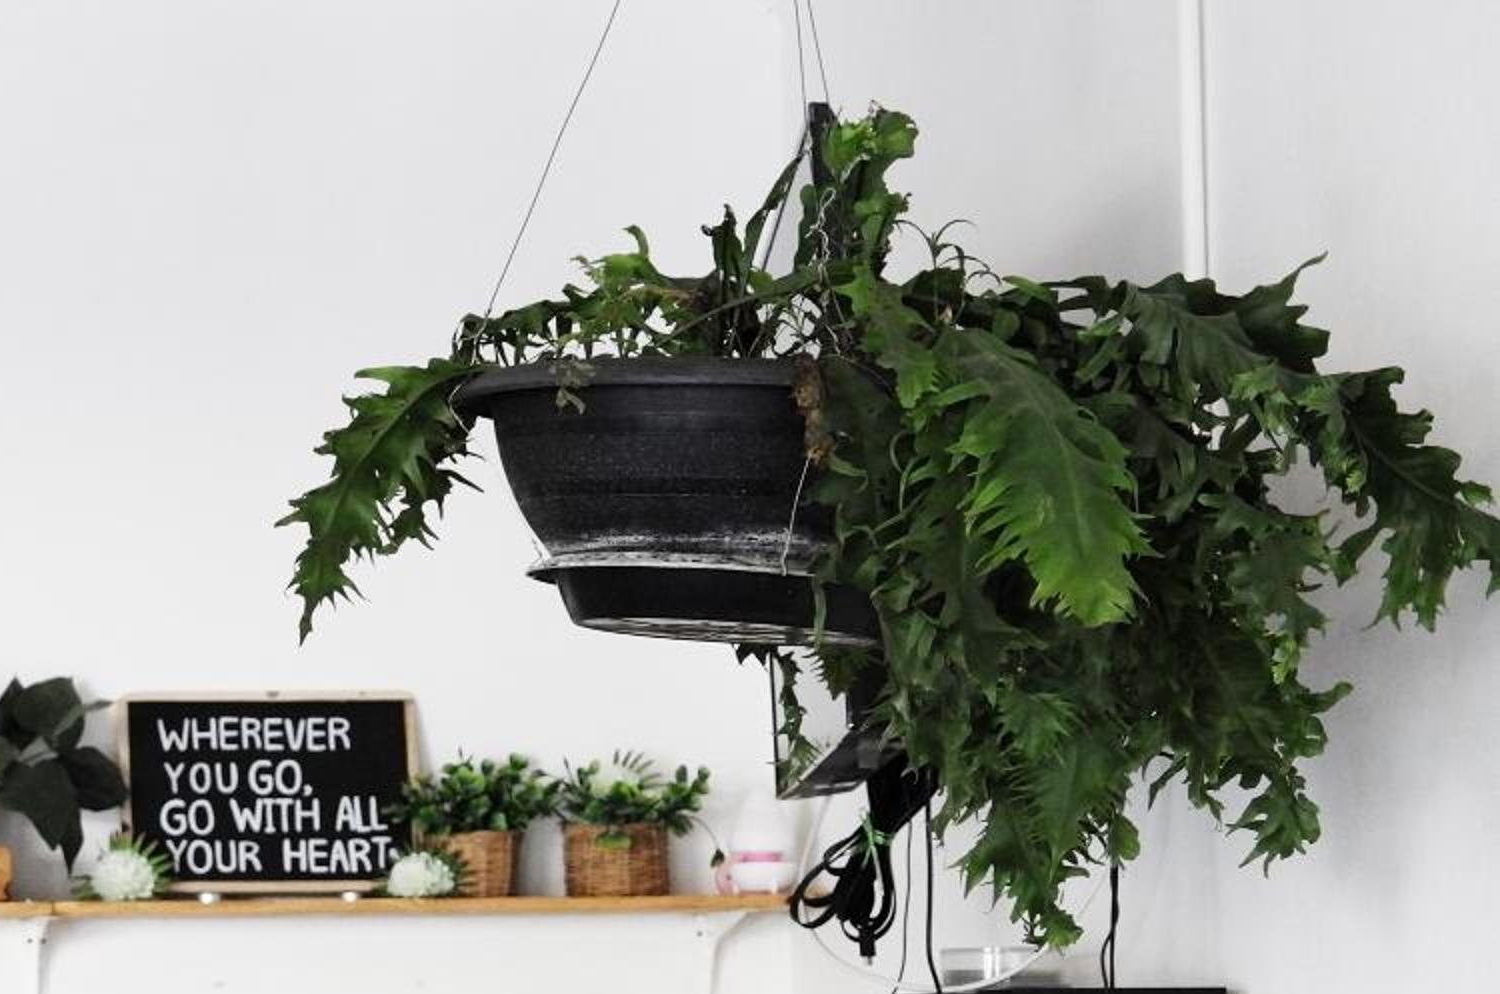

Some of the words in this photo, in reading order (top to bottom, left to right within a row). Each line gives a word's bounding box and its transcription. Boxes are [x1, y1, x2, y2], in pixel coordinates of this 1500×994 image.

[157, 716, 351, 752] WHEREVER
[163, 762, 239, 794] YOU
[248, 759, 313, 796] GO,
[159, 798, 215, 836] GO
[229, 798, 321, 833] WITH
[335, 795, 388, 832] ALL
[165, 840, 263, 874] YOUR
